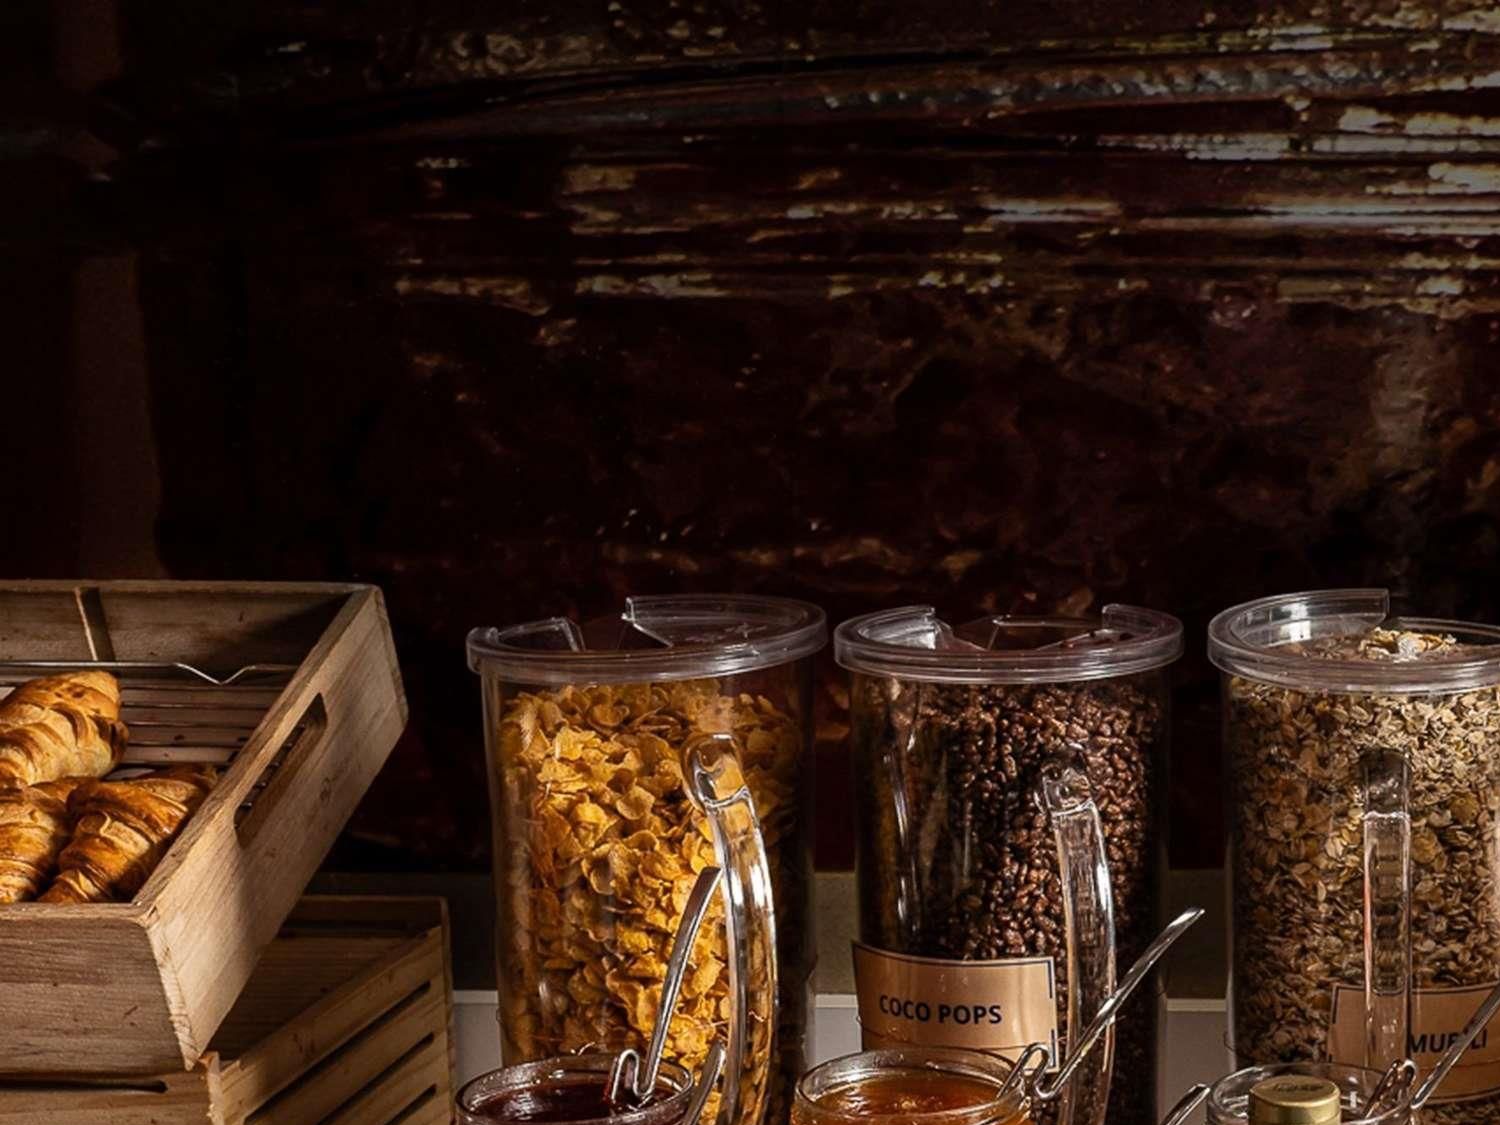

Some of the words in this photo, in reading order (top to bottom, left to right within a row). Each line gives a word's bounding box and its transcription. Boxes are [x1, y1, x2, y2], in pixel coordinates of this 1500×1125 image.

[879, 995, 931, 1022] COCO
[938, 1005, 1002, 1025] POPS
[1408, 1029, 1488, 1053] MUELI
